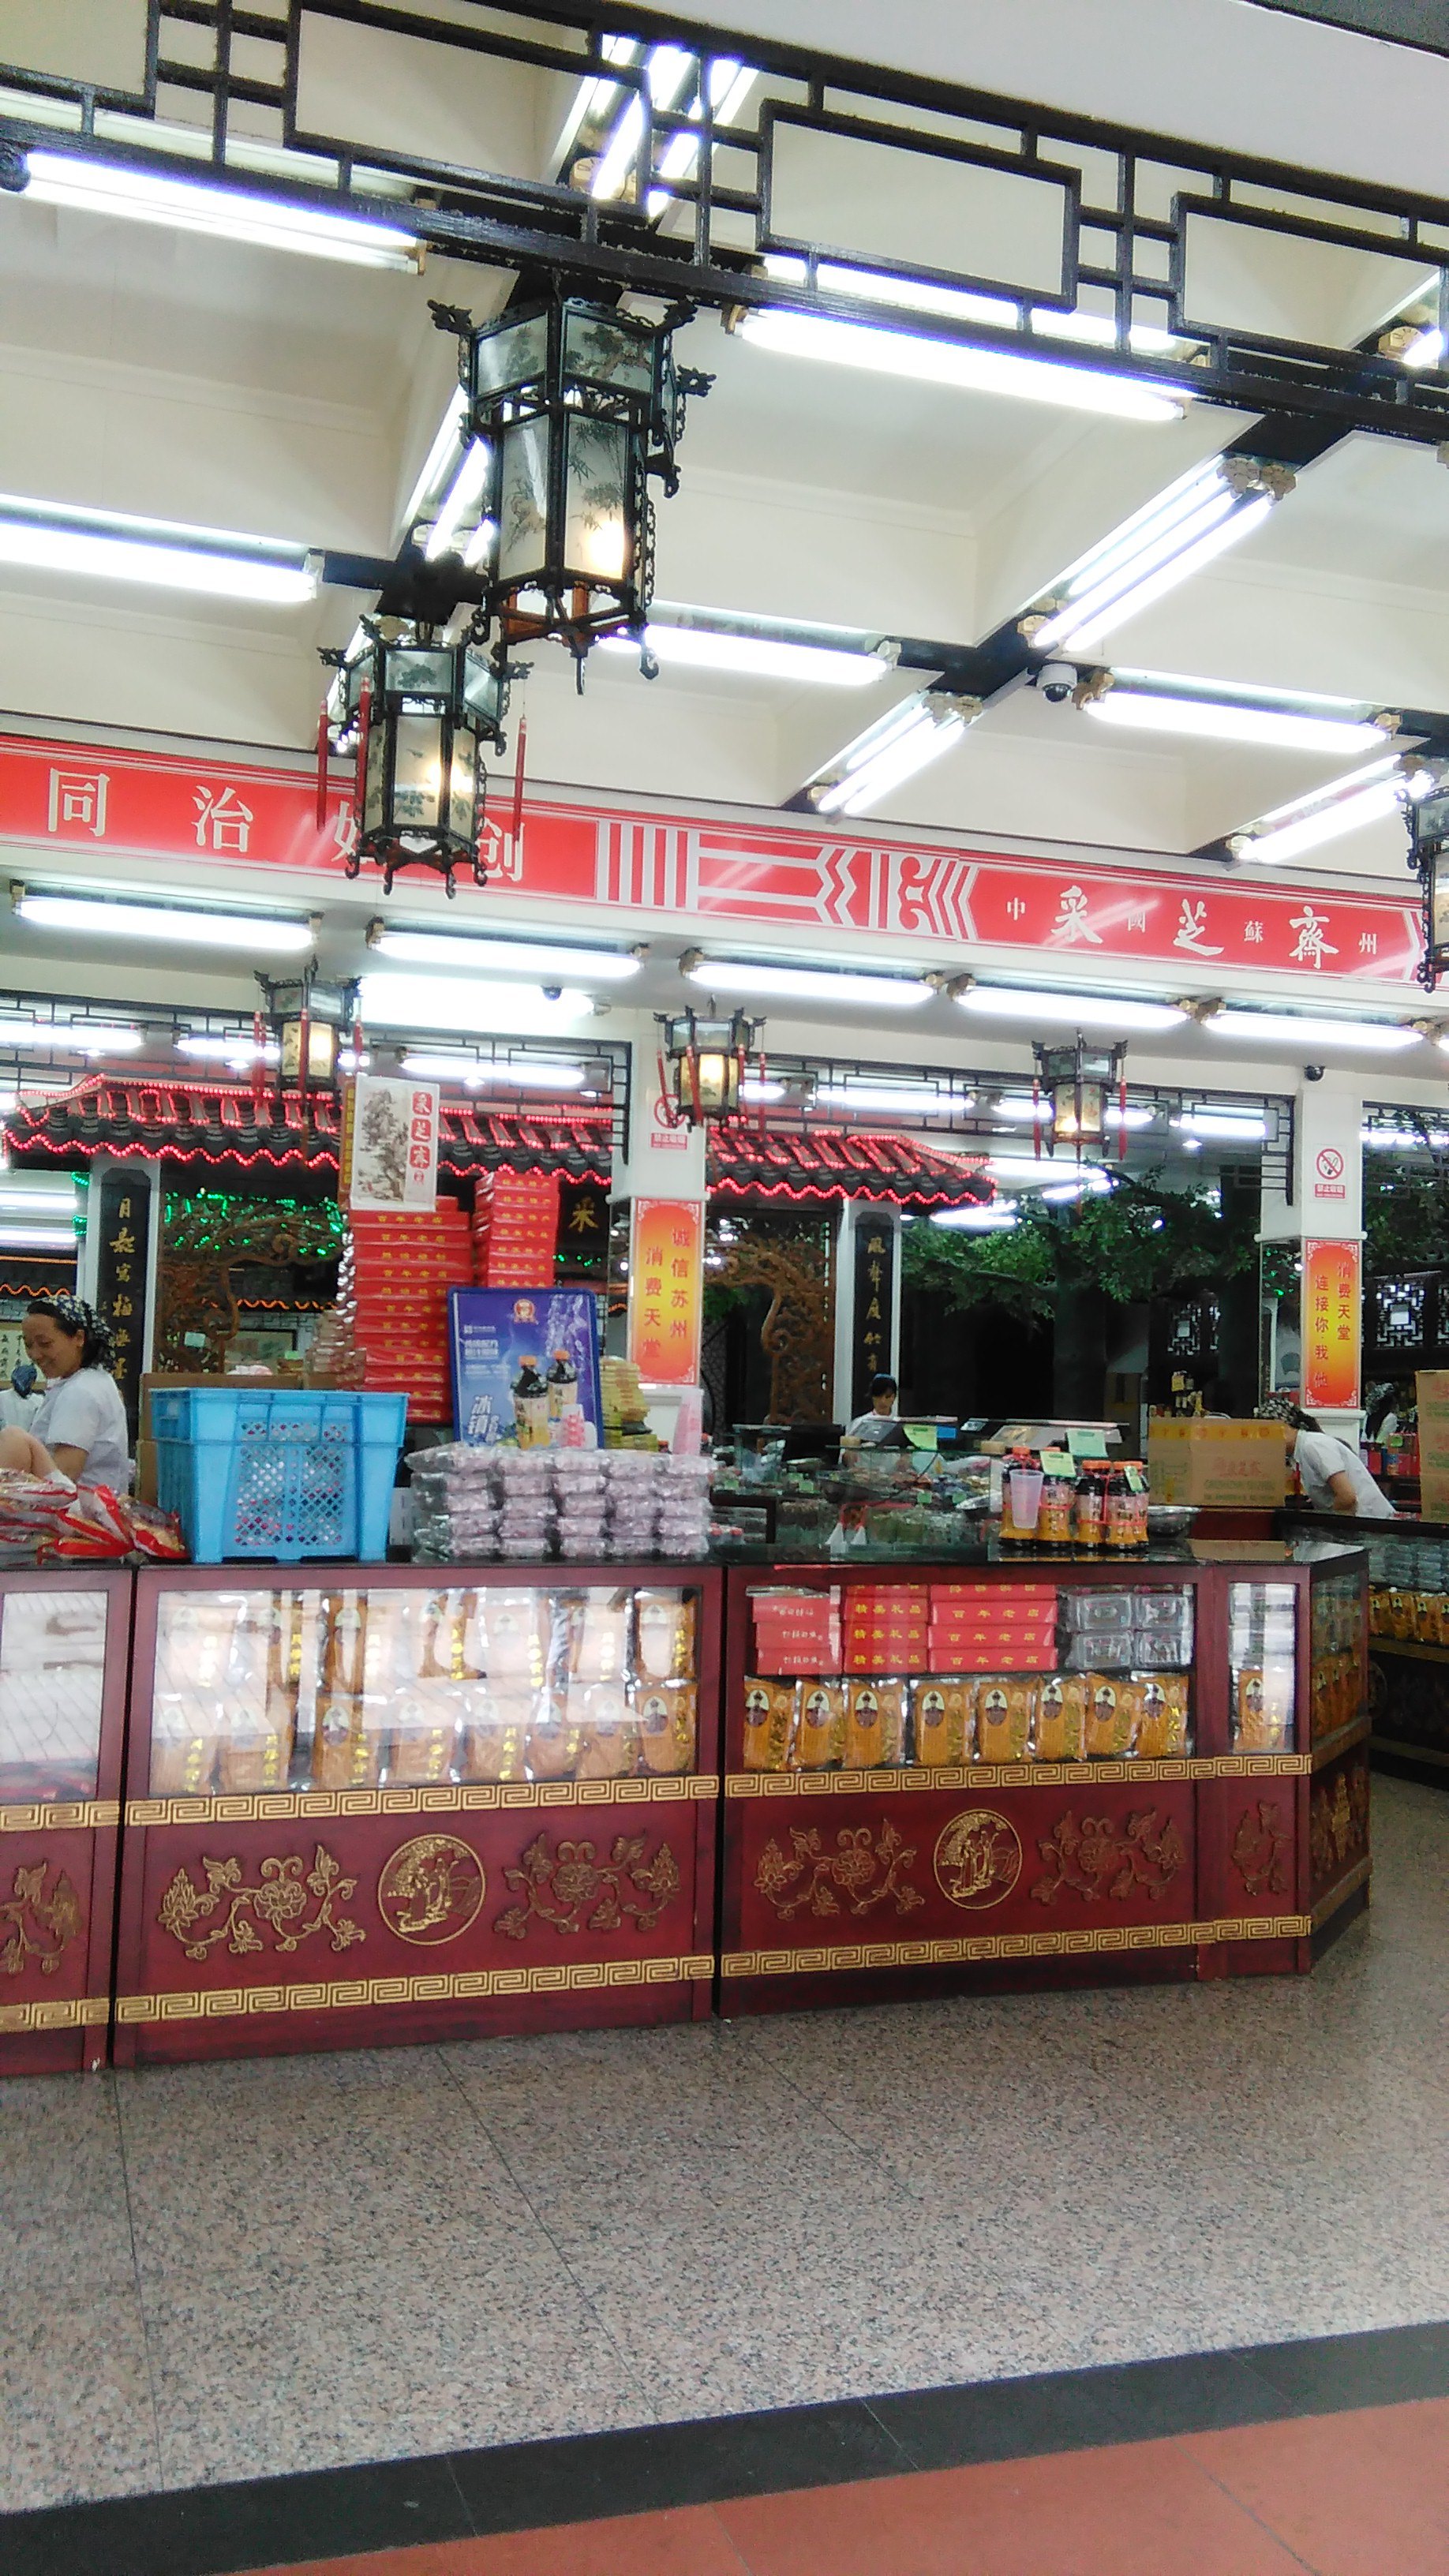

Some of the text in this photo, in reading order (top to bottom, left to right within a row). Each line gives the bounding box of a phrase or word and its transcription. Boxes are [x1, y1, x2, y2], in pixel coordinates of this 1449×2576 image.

[643, 1245, 664, 1359] 消费天堂
[671, 1227, 691, 1339] 诚信苏州
[1337, 1261, 1351, 1341] 消费天堂
